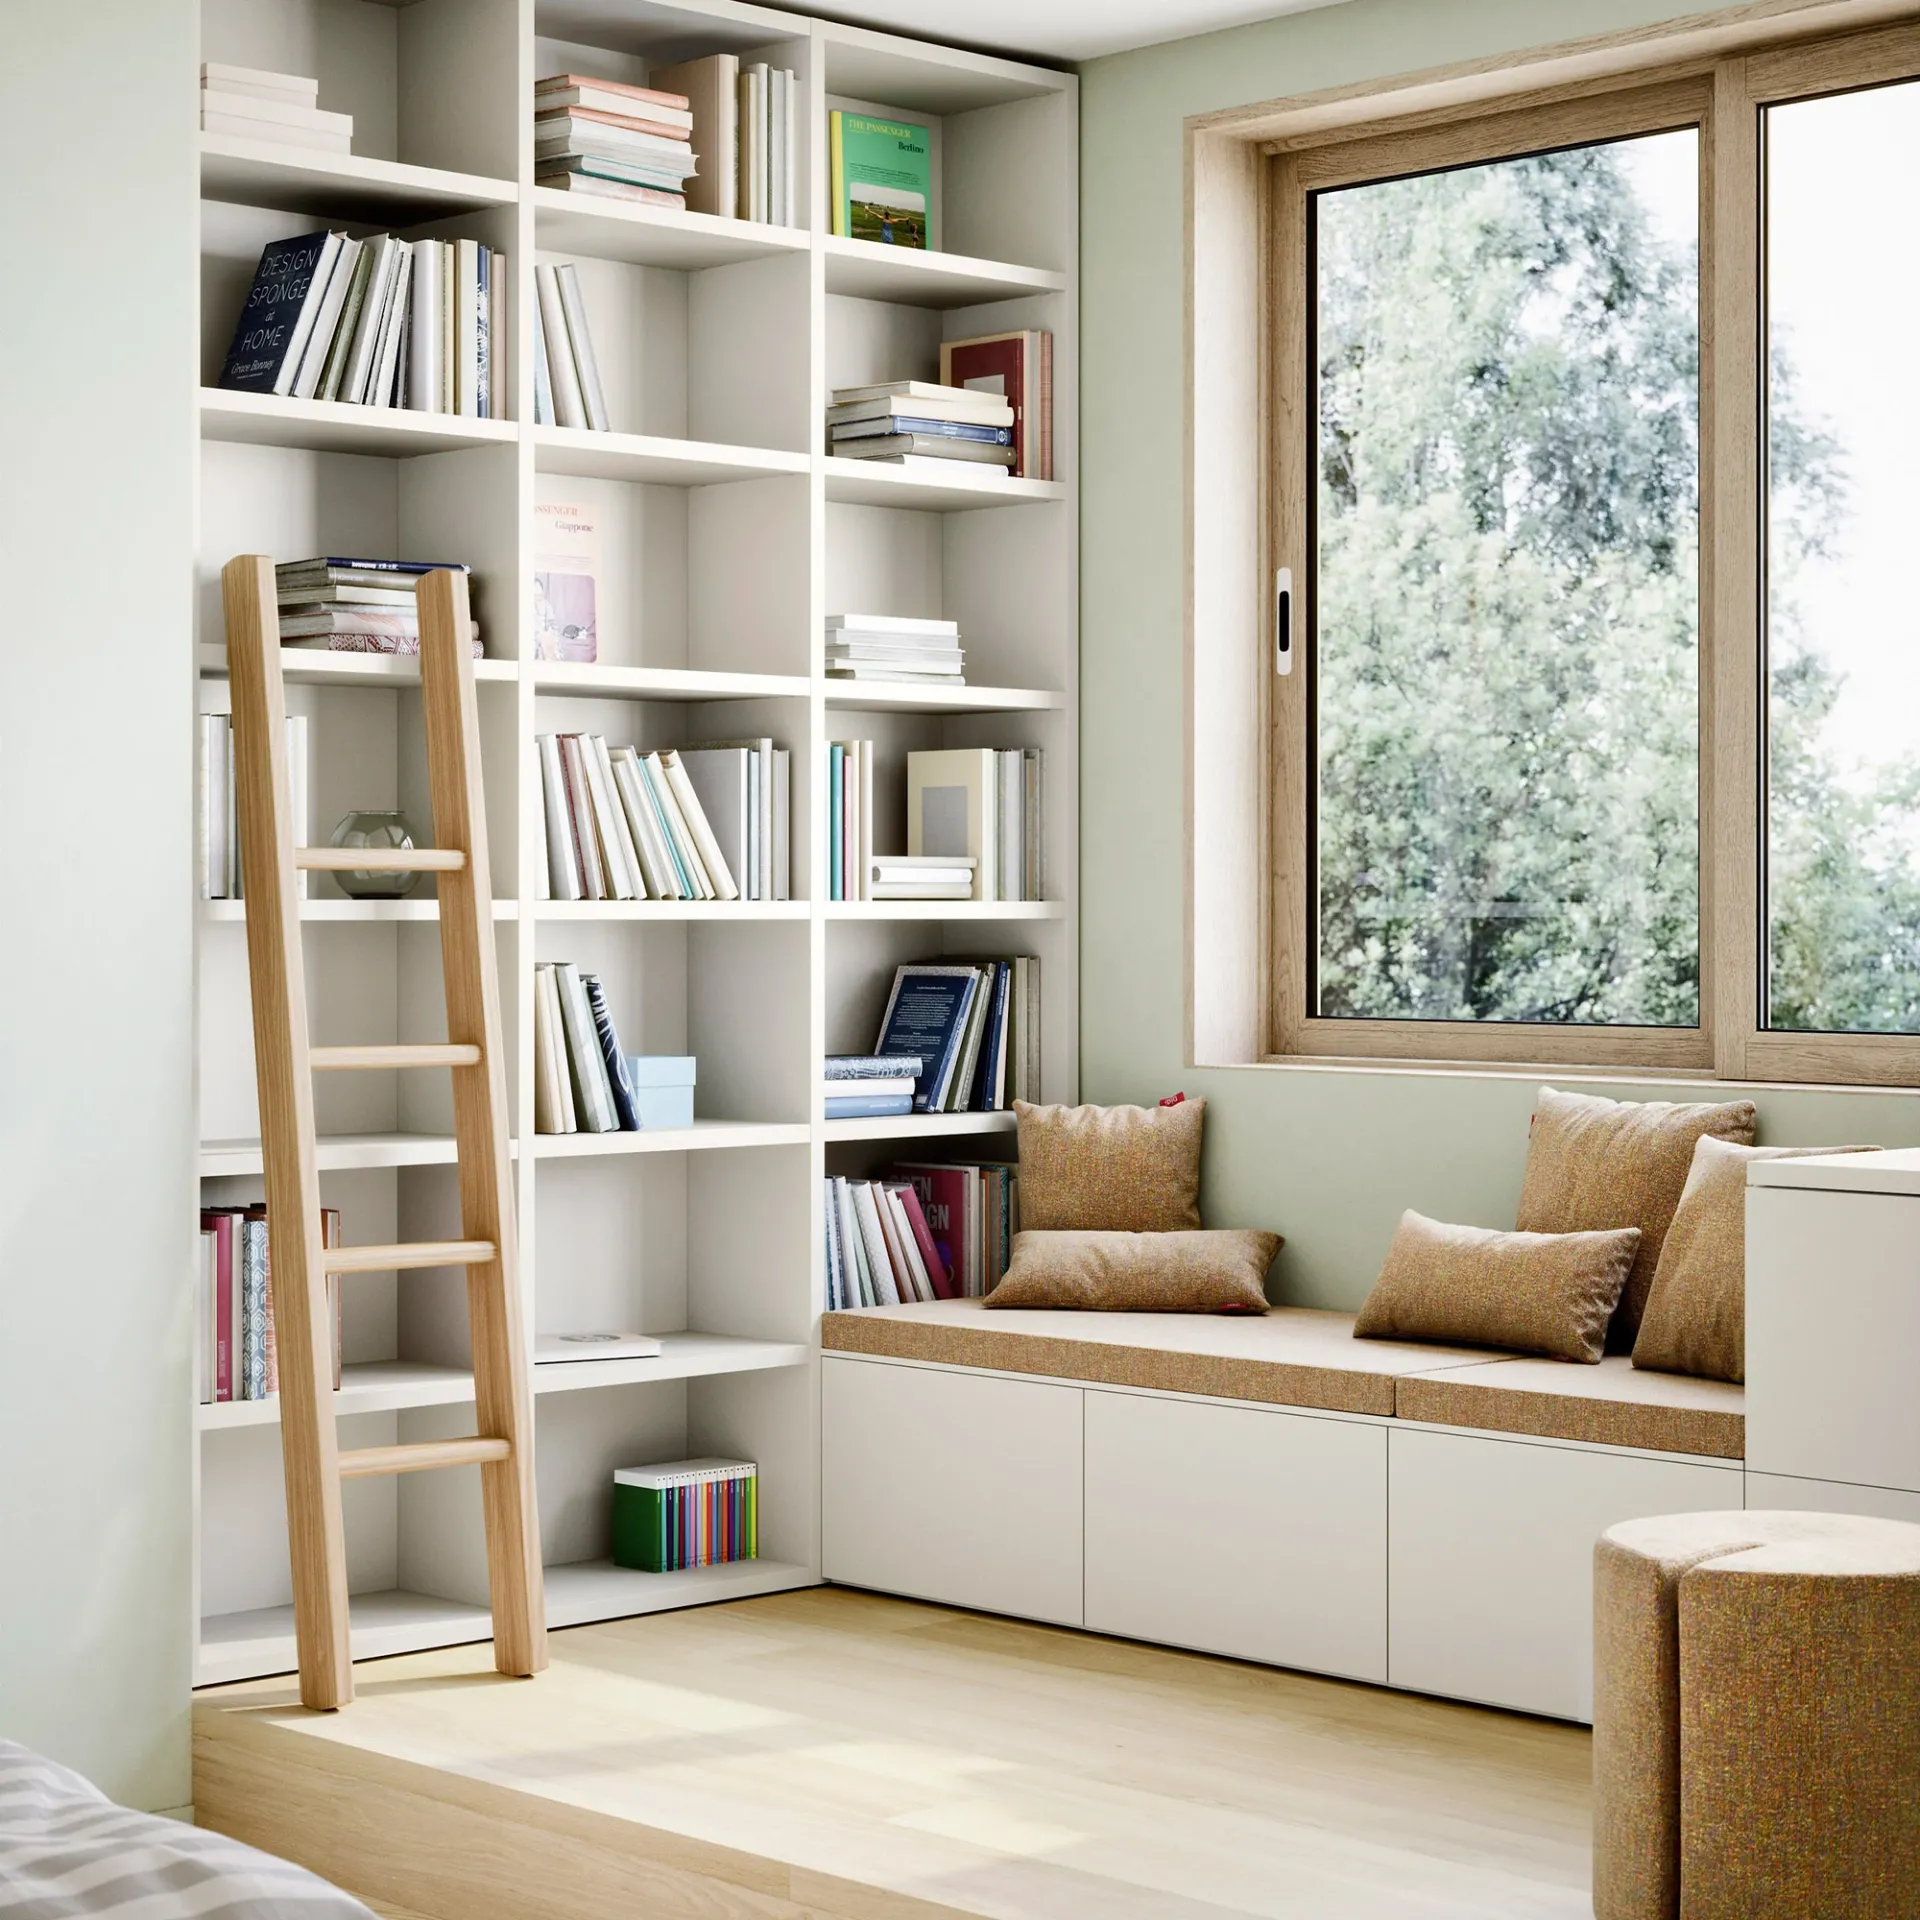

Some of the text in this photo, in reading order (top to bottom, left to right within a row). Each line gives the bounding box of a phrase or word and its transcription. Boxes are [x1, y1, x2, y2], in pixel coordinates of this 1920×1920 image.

[848, 119, 865, 130] THE
[866, 122, 911, 139] PASSENGER
[898, 141, 924, 154] Berlino
[261, 249, 318, 277] DESIGN
[249, 277, 310, 308] SPONGE
[265, 309, 276, 322] at
[241, 325, 285, 352] HOME
[231, 358, 275, 375] Grace Bonney
[534, 504, 578, 517] SSENGER
[555, 520, 594, 533] Giappone
